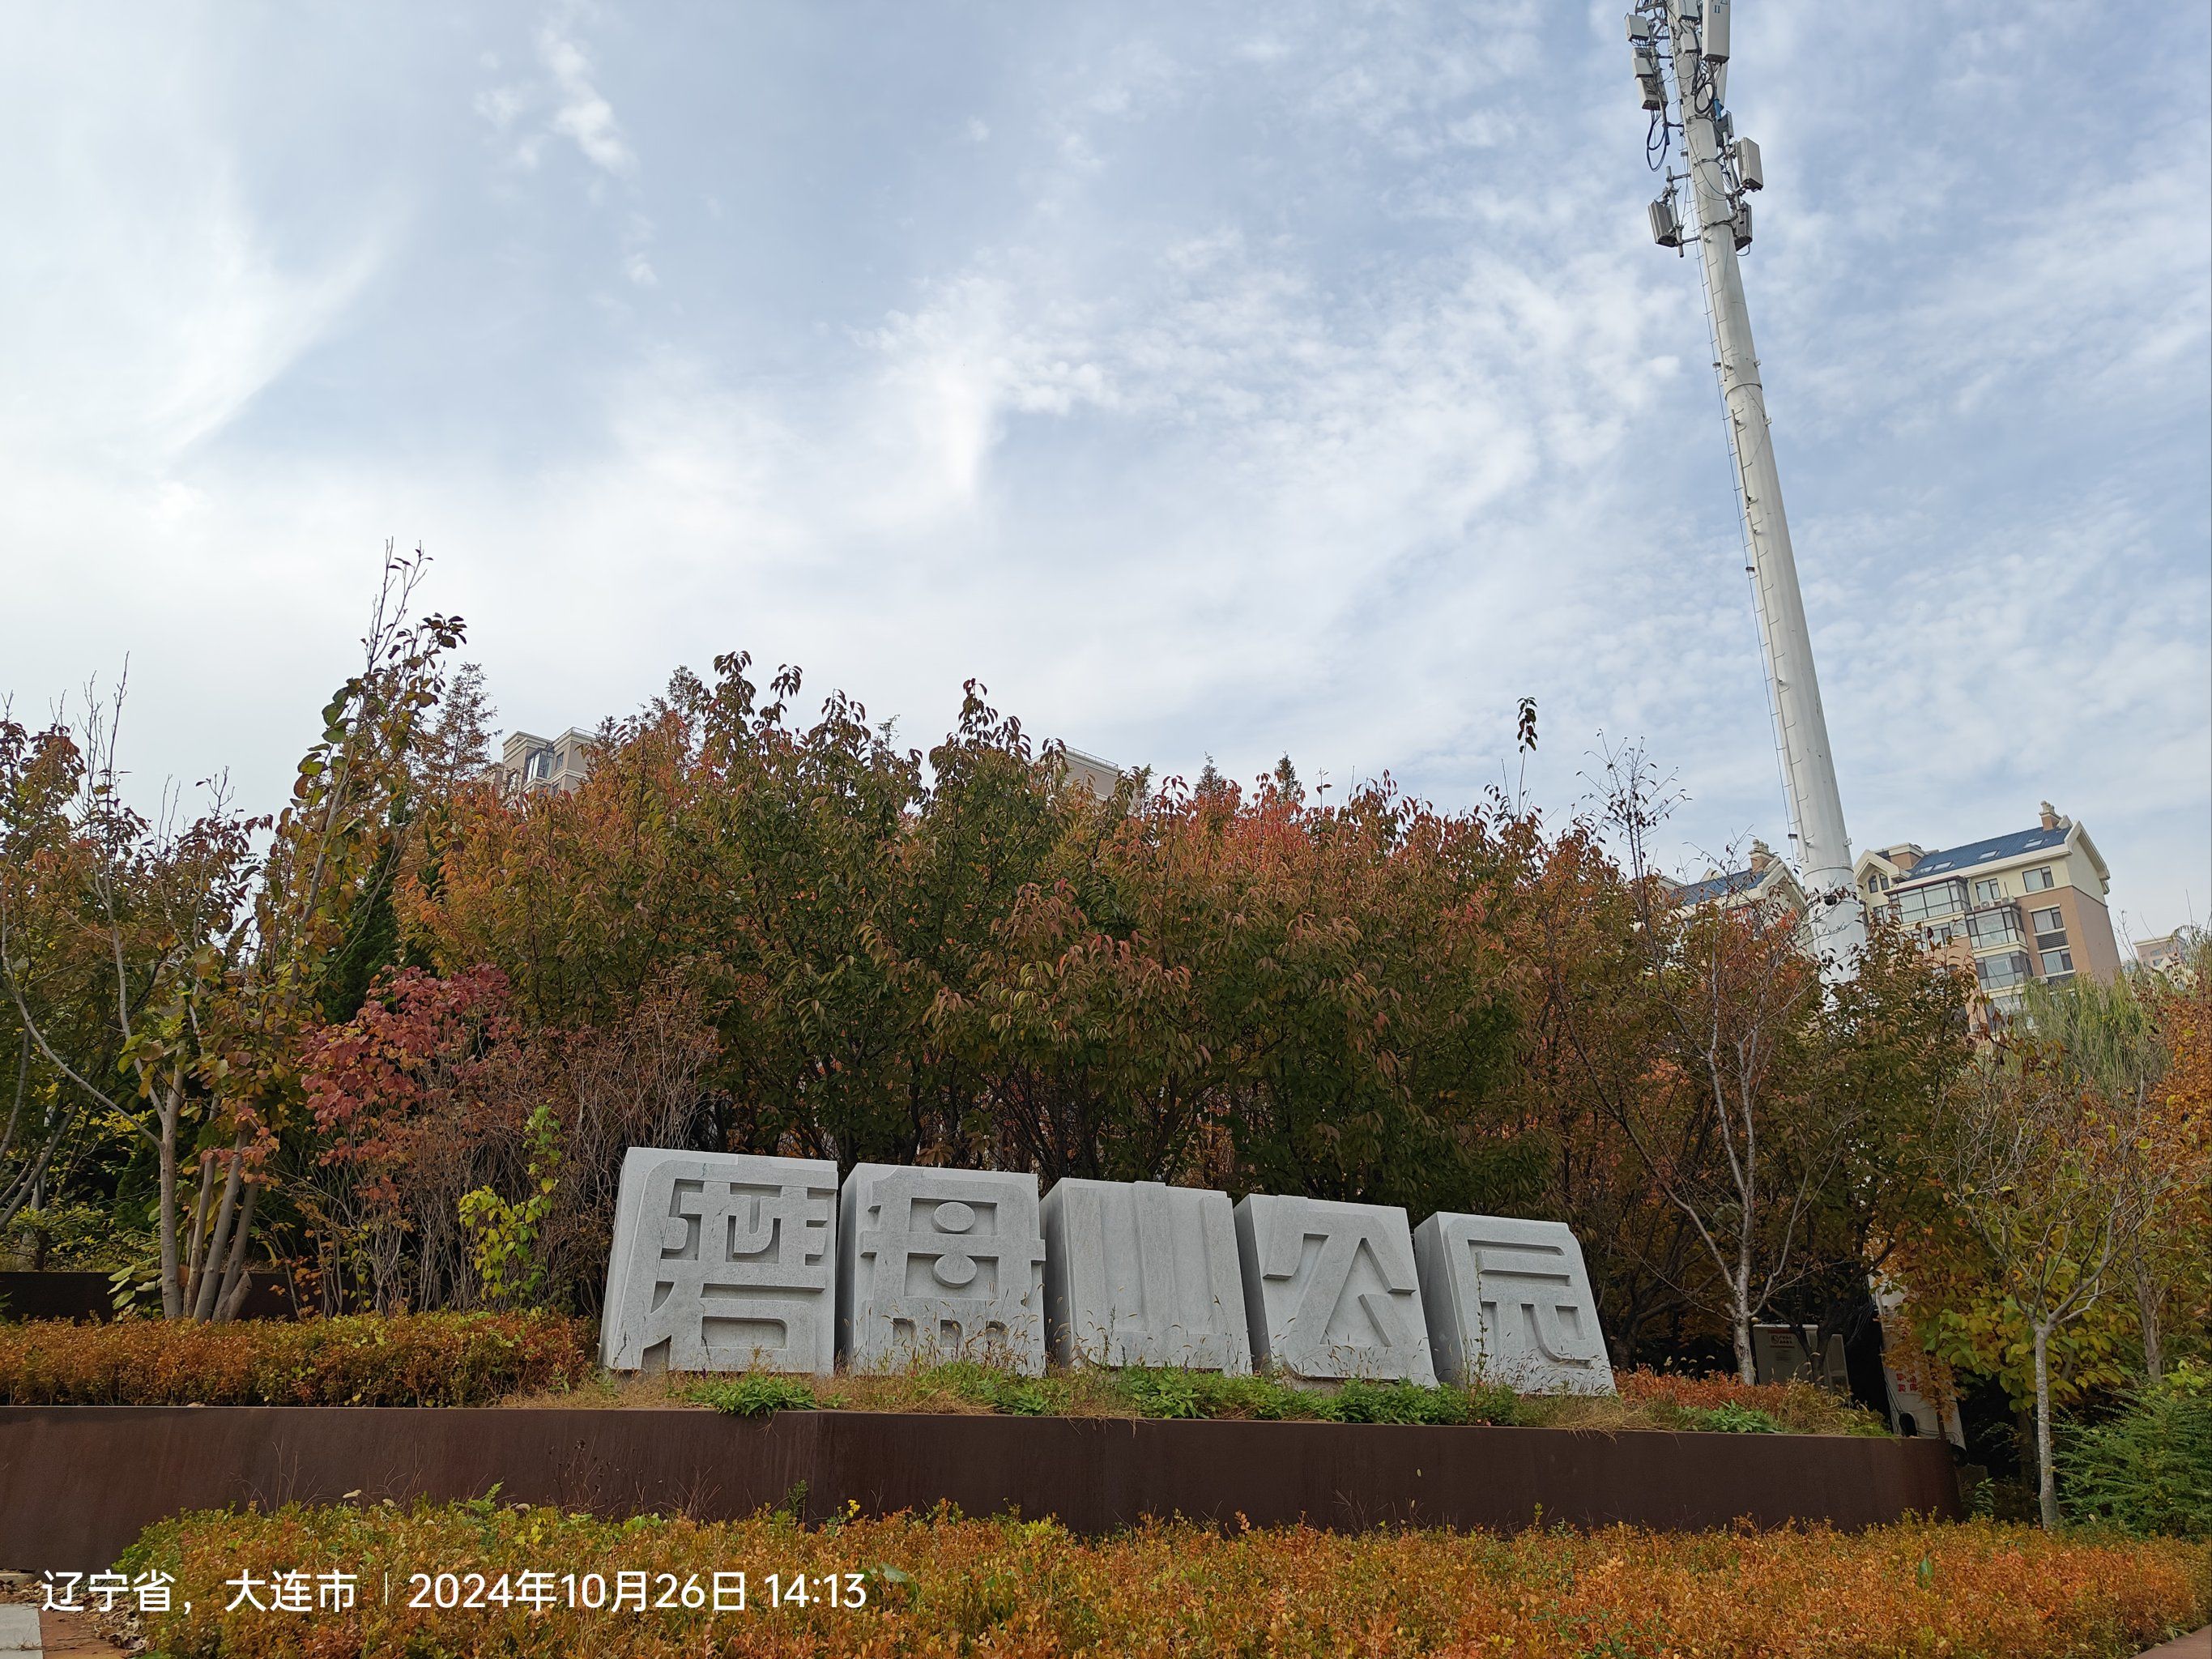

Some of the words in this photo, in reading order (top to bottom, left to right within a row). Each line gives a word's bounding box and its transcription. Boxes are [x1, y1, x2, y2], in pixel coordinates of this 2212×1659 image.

[599, 1150, 1613, 1395] 磨盘山公园
